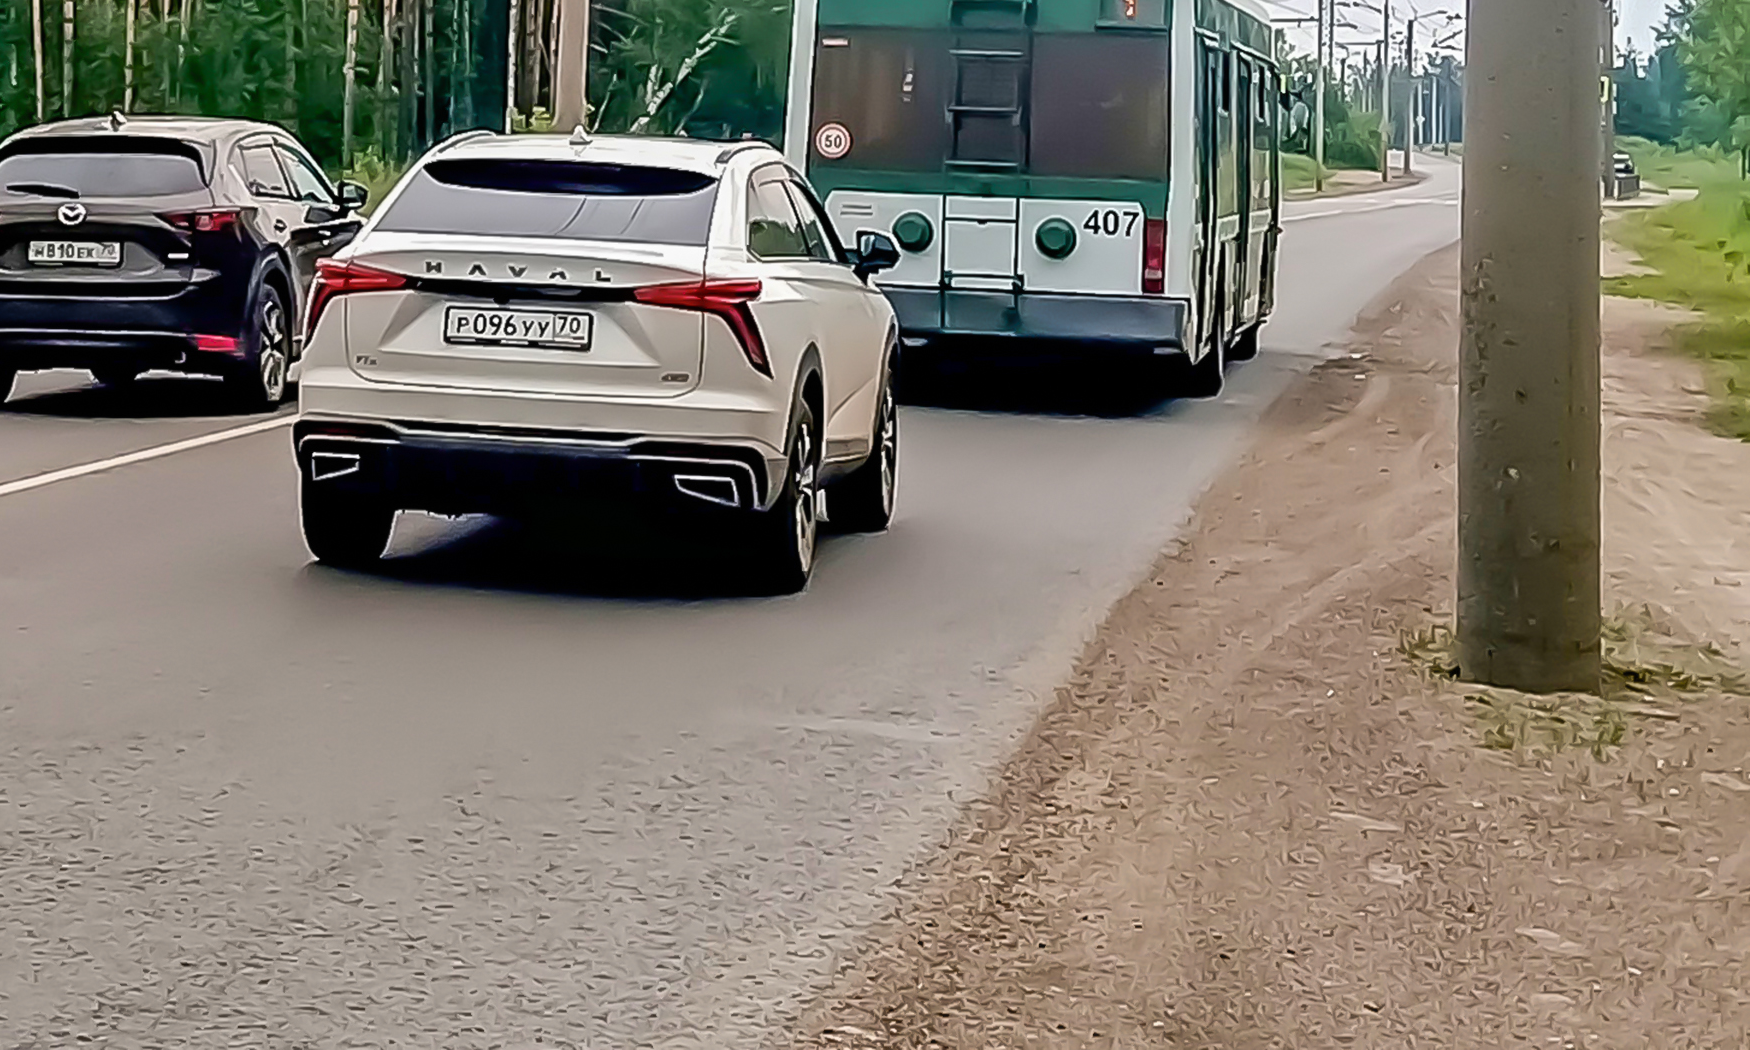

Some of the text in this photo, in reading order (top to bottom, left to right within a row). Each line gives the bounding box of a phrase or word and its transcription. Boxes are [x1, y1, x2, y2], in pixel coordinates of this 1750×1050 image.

[824, 134, 842, 149] 50
[1083, 209, 1140, 237] 407
[425, 260, 612, 283] HAVAL
